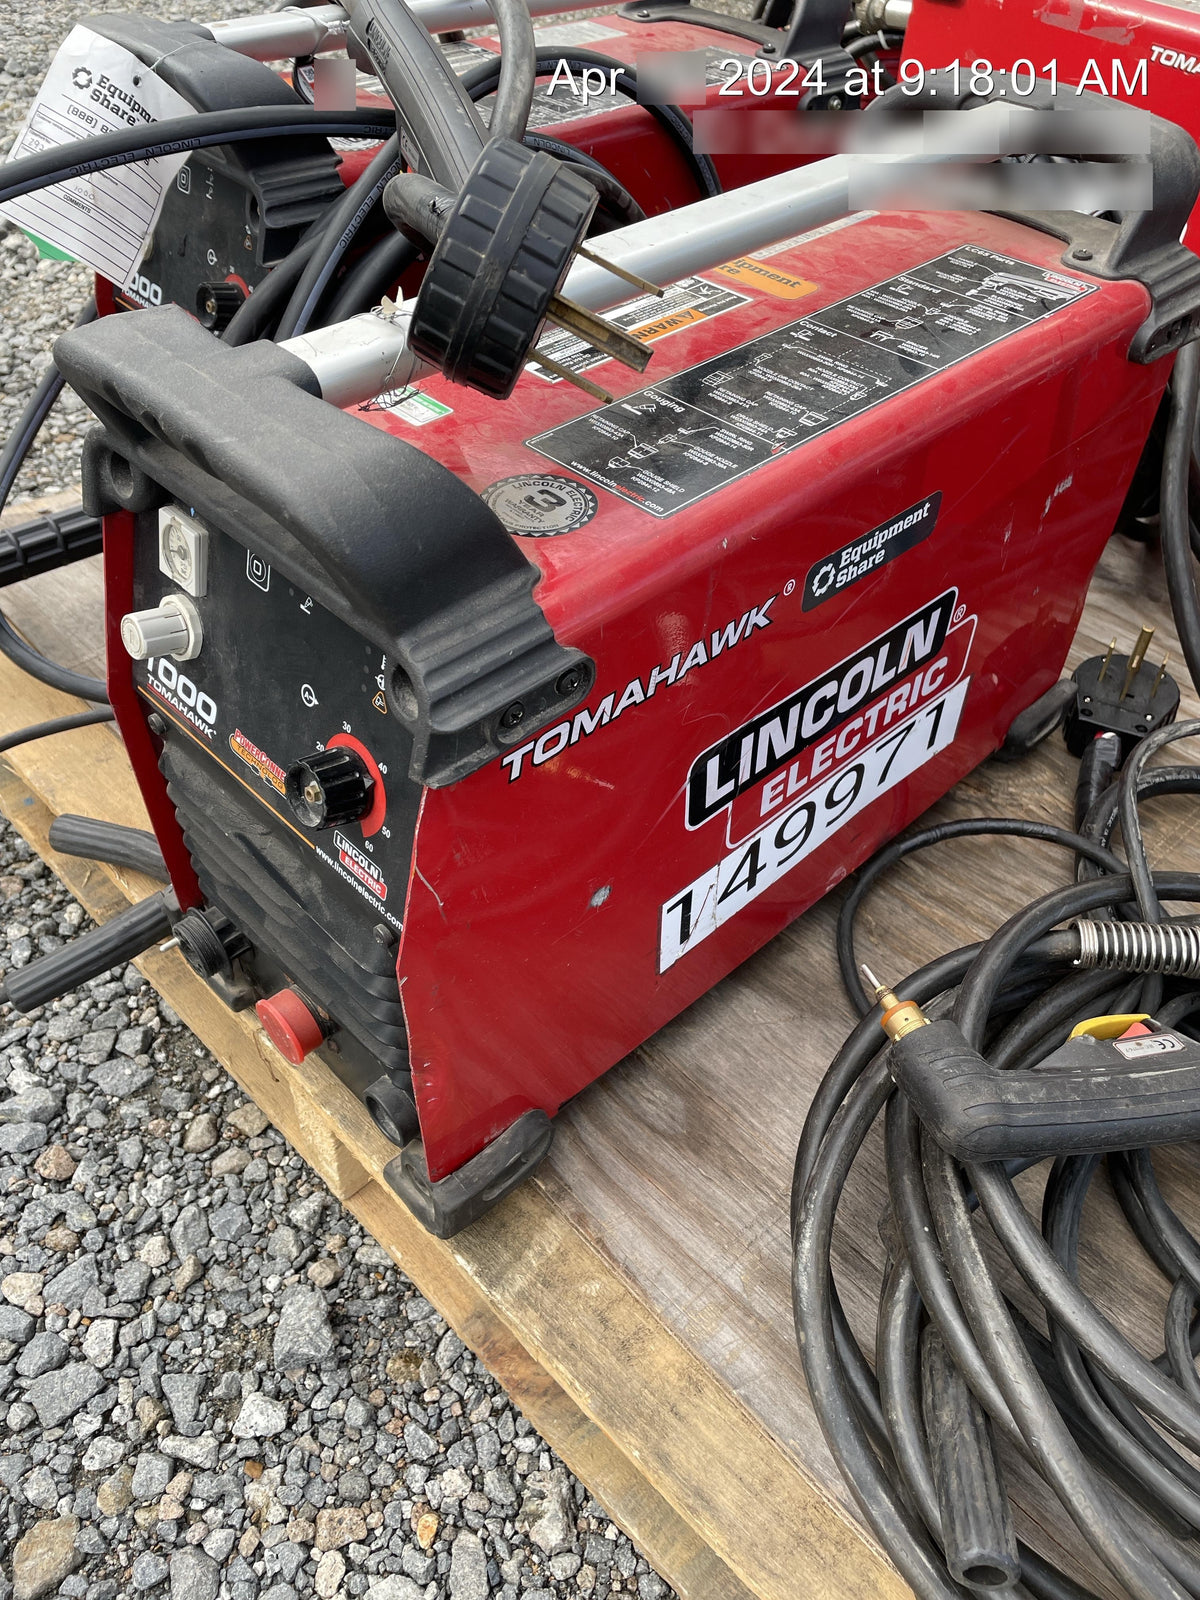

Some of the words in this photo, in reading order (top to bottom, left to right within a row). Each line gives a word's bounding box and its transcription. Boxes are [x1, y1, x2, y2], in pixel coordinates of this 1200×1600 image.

[90, 89, 137, 127] Share
[96, 74, 158, 123] Equipm
[69, 152, 135, 176] ELECTRIC
[145, 138, 200, 158] LINCOLN
[63, 194, 91, 213] COMMENTS
[339, 196, 375, 249] ELECTRIC
[733, 258, 801, 289] ipment
[898, 277, 941, 293] Standard
[800, 321, 837, 337] Contact
[644, 391, 684, 412] Gouging
[512, 480, 567, 492] LINCOLN
[566, 489, 584, 522] ELECTRIC
[524, 489, 567, 513] 3
[572, 462, 663, 512] www.lincolnelectric.com
[663, 481, 685, 492] SHIELD
[505, 499, 545, 523] WARRANTY
[518, 499, 545, 517] YEAR
[839, 501, 931, 567] Equipment
[835, 546, 886, 590] Share
[147, 673, 215, 739] TOMAHAWK
[501, 595, 779, 784] TOMAHAWK
[705, 606, 943, 808] LINCOLN
[342, 721, 351, 733] 30
[760, 657, 949, 818] ELECTRIC
[316, 741, 325, 751] 20
[237, 745, 284, 791] TECHNOLOG
[378, 762, 388, 775] 40
[382, 826, 391, 839] 50
[666, 696, 946, 946] 149971
[336, 834, 379, 881] LINCOLN
[364, 840, 374, 853] 60
[315, 847, 404, 932] www.lincolnelectric.com
[344, 856, 383, 894] ELECTRIC
